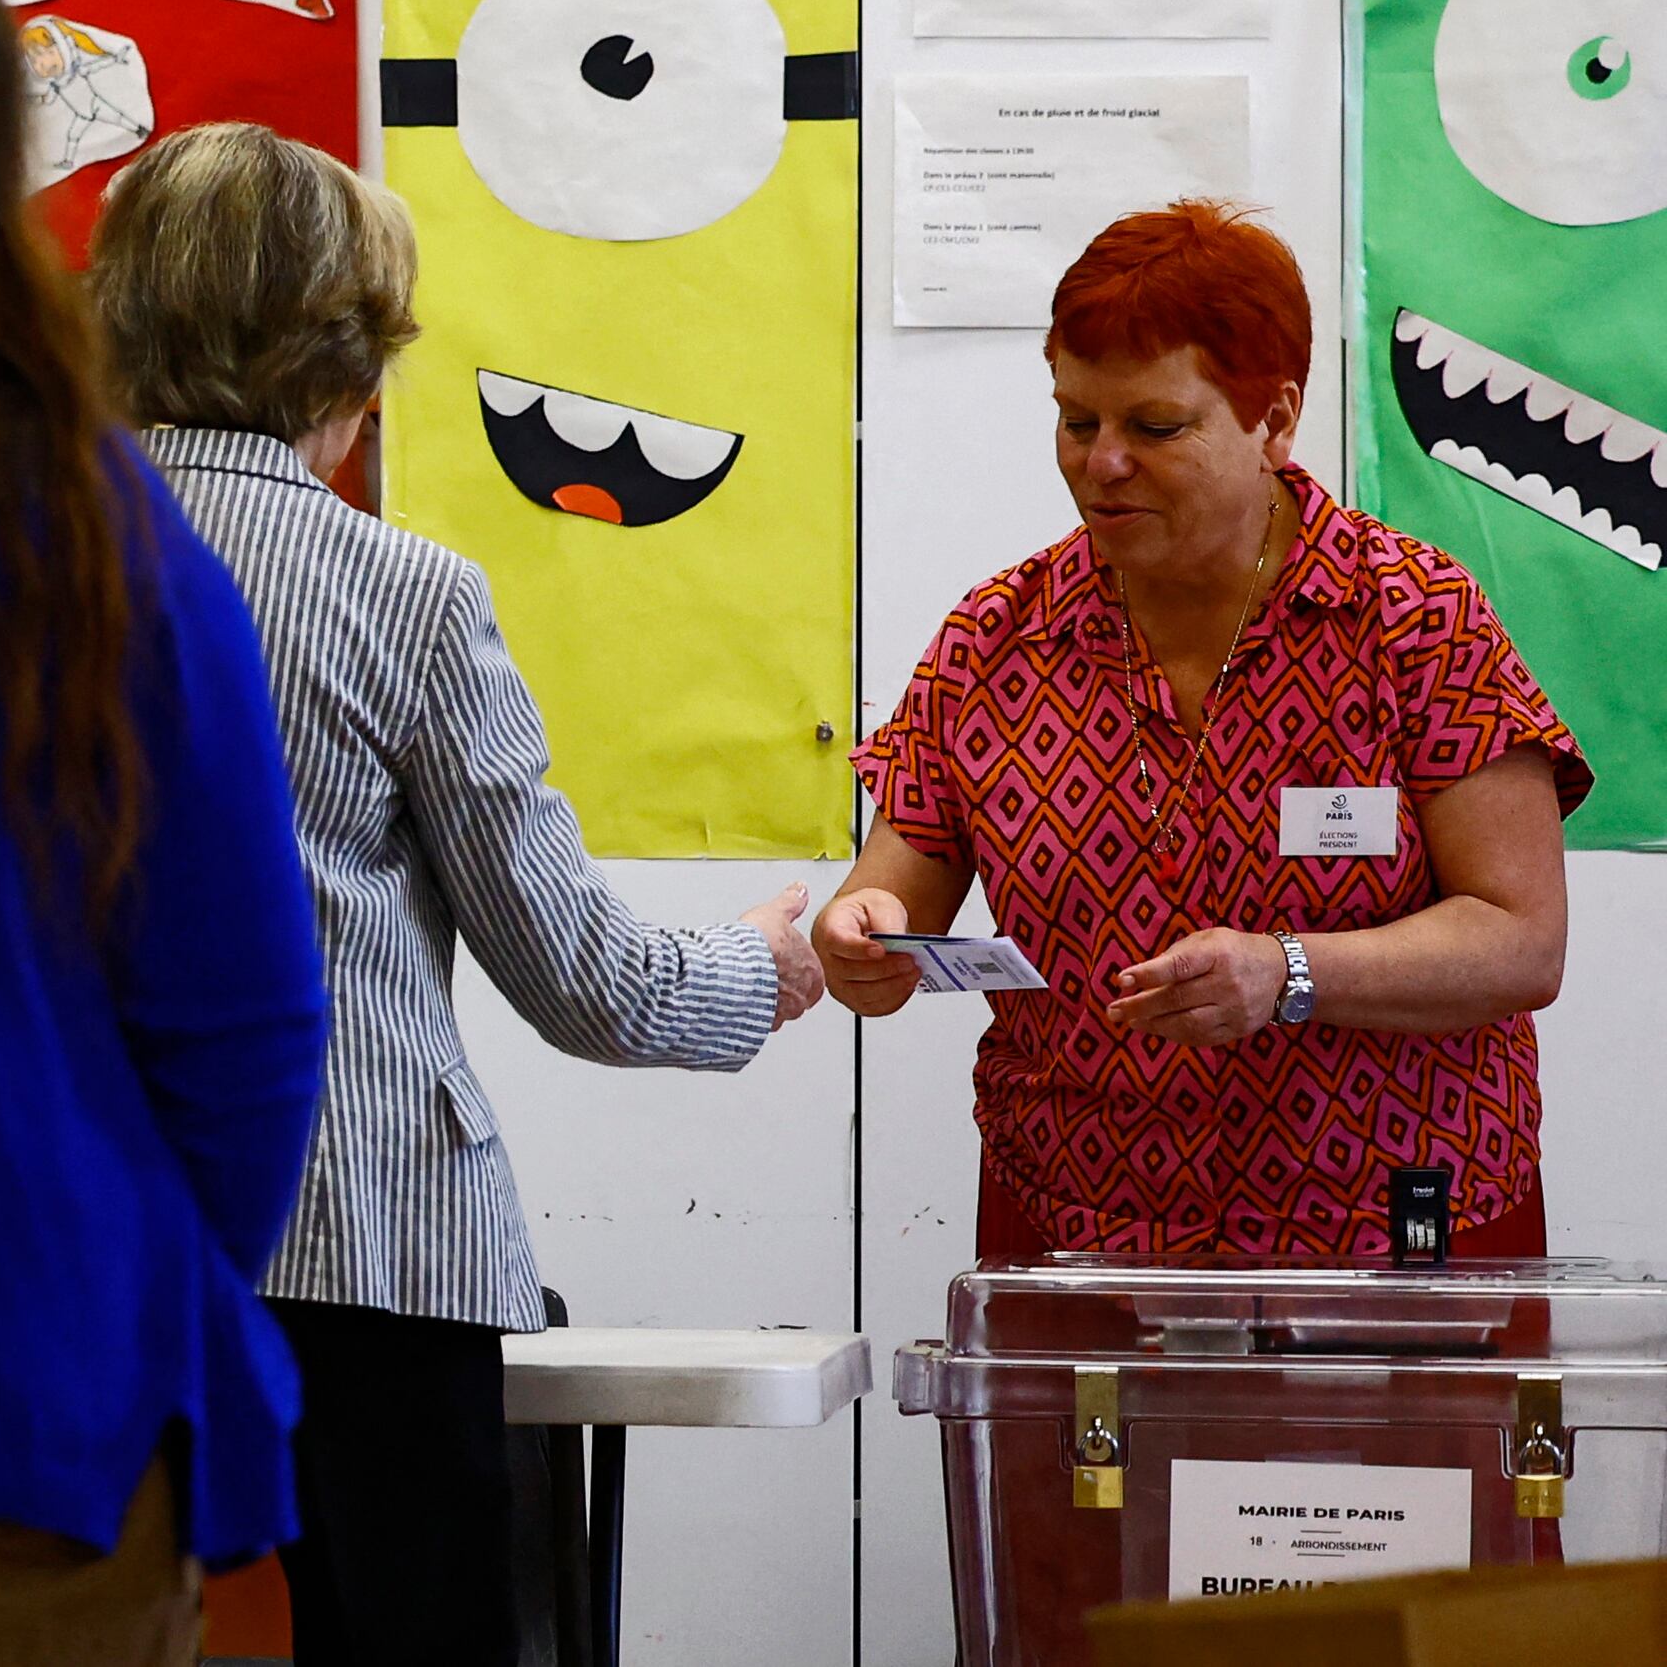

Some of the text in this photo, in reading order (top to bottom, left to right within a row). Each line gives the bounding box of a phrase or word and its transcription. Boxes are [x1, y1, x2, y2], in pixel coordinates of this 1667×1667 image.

[998, 108, 1011, 117] En
[1032, 108, 1044, 117] de
[1047, 108, 1071, 118] pluie
[1074, 109, 1084, 117] et
[1087, 108, 1099, 117] de
[1102, 108, 1126, 117] froid
[1128, 108, 1160, 118] glacial
[1325, 812, 1353, 820] PARIS
[1319, 830, 1358, 839] ÉLECTIONS
[1238, 1505, 1405, 1522] MAIRIE DE PARIS
[1249, 1536, 1263, 1547] 18
[1290, 1540, 1388, 1552] ARRONDISSEMENT
